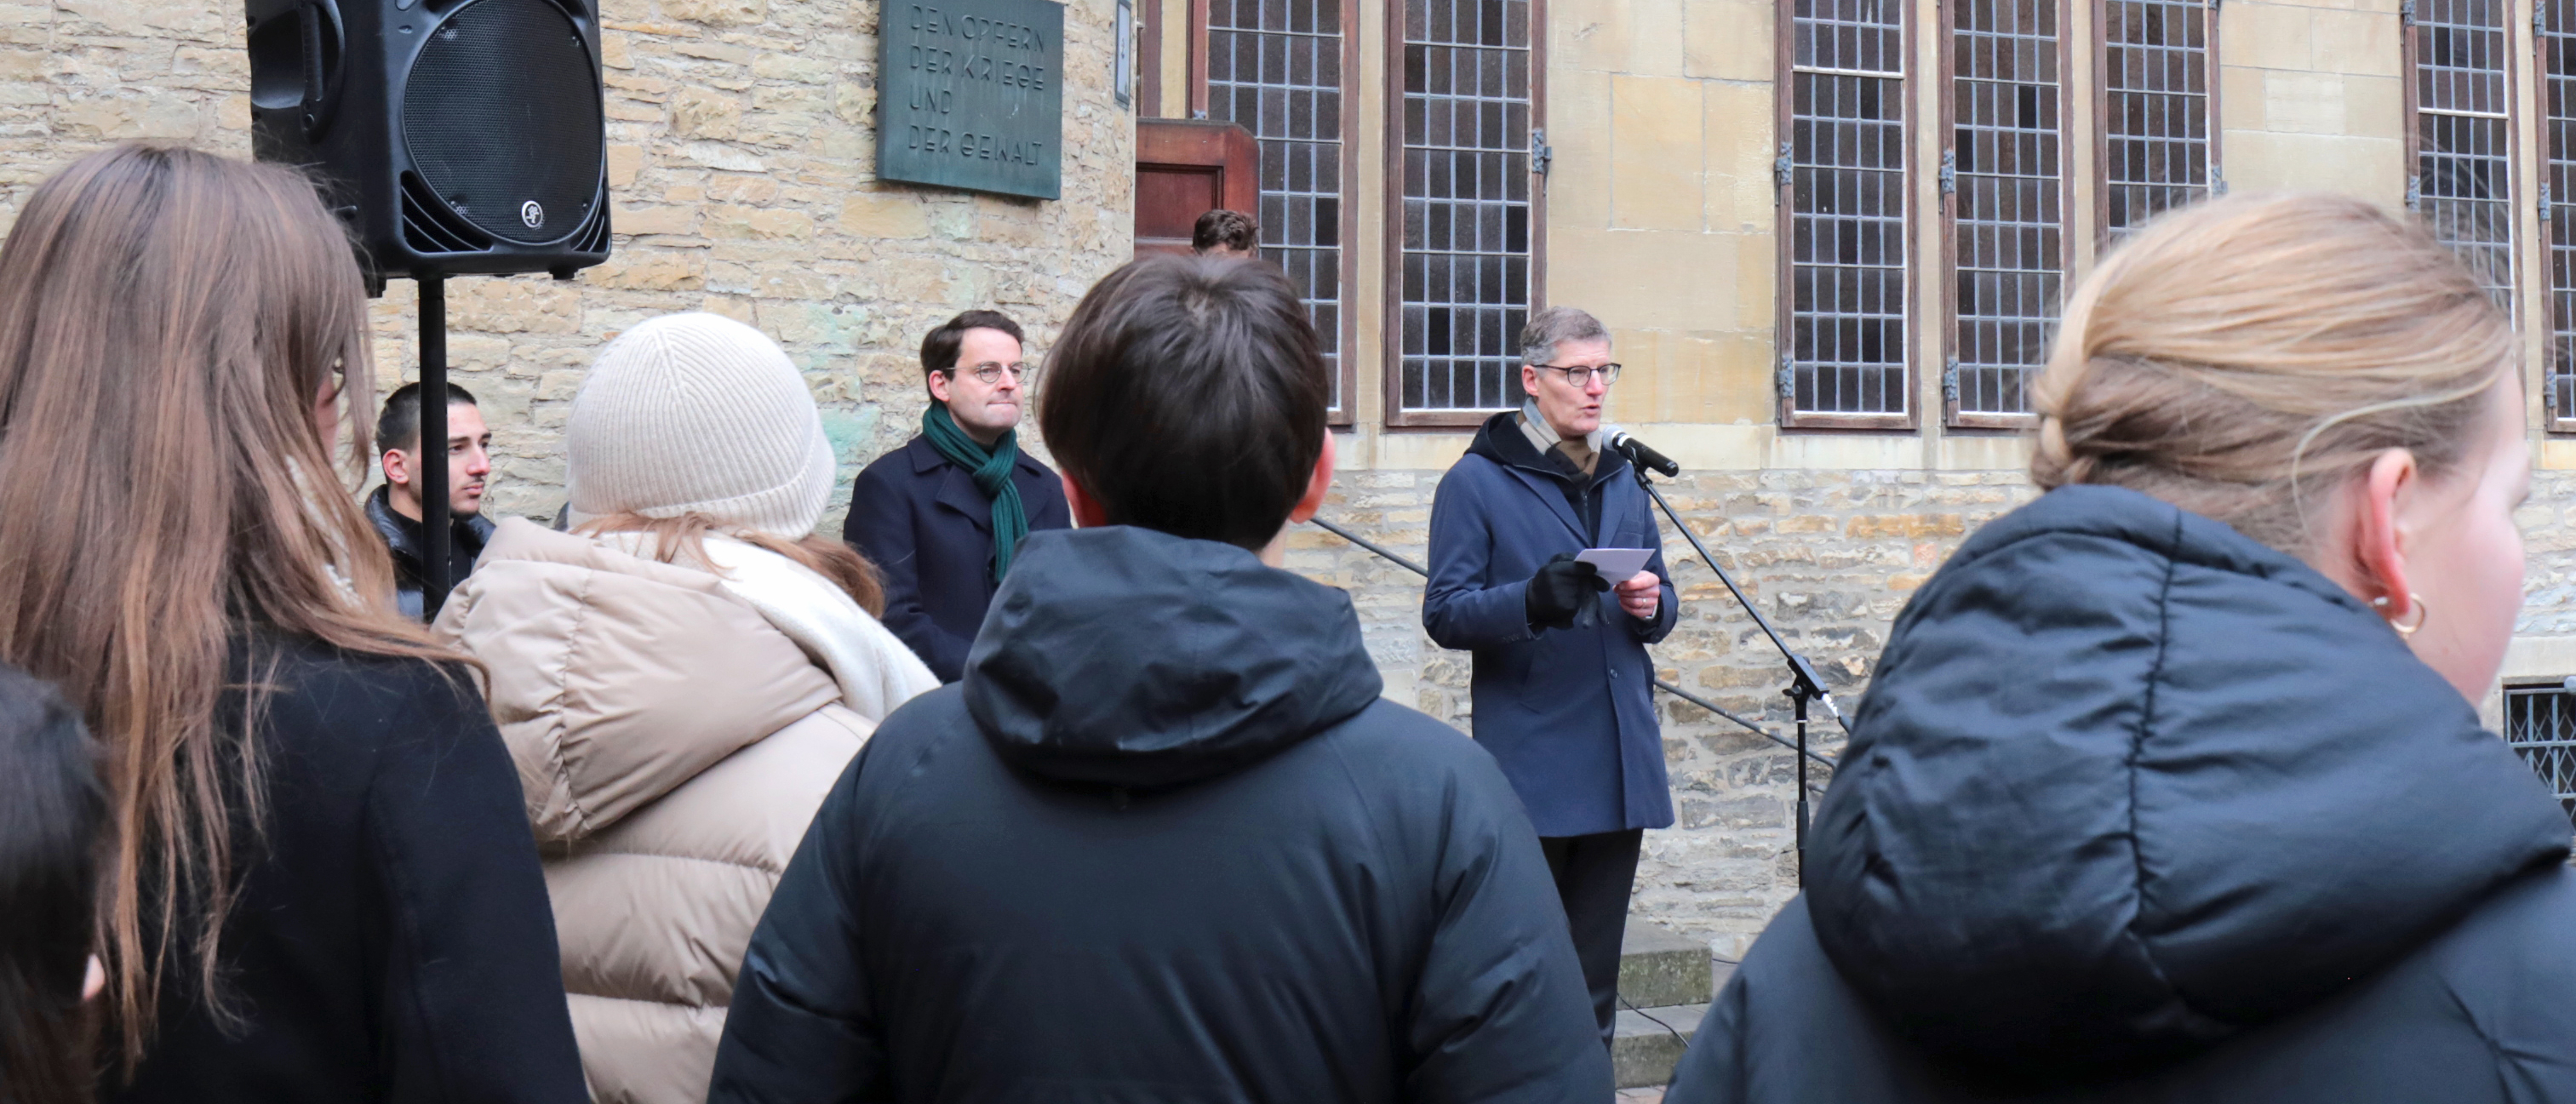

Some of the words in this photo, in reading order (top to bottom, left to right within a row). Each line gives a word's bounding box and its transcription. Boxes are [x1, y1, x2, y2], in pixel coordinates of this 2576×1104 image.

[911, 3, 953, 36] DEN
[961, 14, 1045, 53] OPFERN
[910, 43, 952, 75] DER
[961, 54, 1044, 90] KRIEGE
[910, 84, 952, 114] UND
[908, 124, 951, 153] DER
[960, 132, 1043, 166] GEWALT
